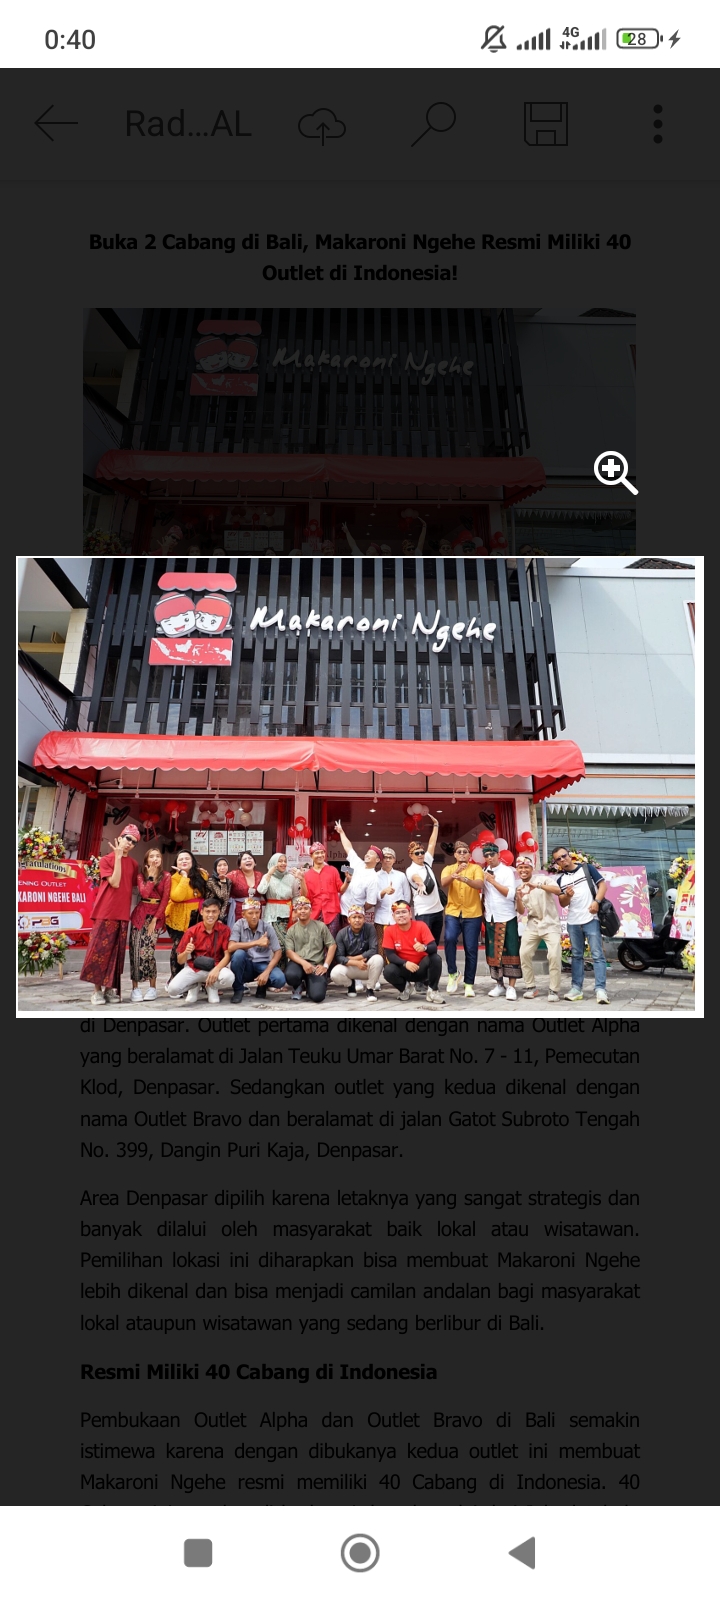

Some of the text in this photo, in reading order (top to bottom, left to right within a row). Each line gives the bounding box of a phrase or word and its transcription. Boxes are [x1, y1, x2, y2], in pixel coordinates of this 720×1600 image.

[44, 29, 97, 50] 0:40
[562, 26, 580, 38] 4G
[626, 31, 648, 47] 28
[89, 233, 632, 254] Buka 2 Cabang di Bali, Makaroni Ngehe Resmi Miliki 40
[261, 264, 458, 282] Outlet di Indonesia!
[272, 347, 475, 385] Makaroni Ngehe
[250, 606, 497, 652] Makaroni Ngehe
[47, 891, 71, 903] NGEHE
[71, 892, 87, 903] BALI
[79, 1018, 640, 1037] di Denpasar. Outlet pertama dikenal dengan nama Outlet Alpha
[79, 1051, 122, 1068] yang
[127, 1047, 215, 1064] beralamat
[218, 1047, 234, 1064] di
[238, 1047, 283, 1064] Jalan
[287, 1047, 342, 1064] Teuku
[347, 1047, 394, 1064] Umar
[399, 1047, 445, 1064] Barat
[449, 1047, 478, 1064] No.
[484, 1047, 495, 1064] 7
[513, 1047, 539, 1068] 11,
[545, 1047, 640, 1064] Pemecutan
[80, 1078, 640, 1099] Klod, Denpasar. Sedangkan outlet yang kedua dikenal dengan
[80, 1110, 640, 1131] nama Outlet Bravo dan beralamat di jalan Gatot Subroto Tengah
[80, 1141, 403, 1162] No. 399, Dangin Puri Kaja, Denpasar.
[79, 1189, 640, 1210] Area Denpasar dipilih karena letaknya yang sangat strategis dan
[80, 1220, 639, 1241] banyak dilalui oleh masyarakat baik lokal atau wisatawan.
[80, 1251, 641, 1272] Pemilihan lokasi ini diharapkan bisa membuat Makaroni Ngehe
[80, 1282, 641, 1303] lebih dikenal dan bisa menjadi camilan andalan bagi masyarakat
[80, 1314, 544, 1335] lokal ataupun wisatawan yang sedang berlibur di Bali.
[80, 1363, 438, 1384] Resmi Miliki 40 Cabang di Indonesia
[80, 1411, 640, 1432] Pembukaan Outlet Alpha dan Outlet Bravo di Bali semakin
[80, 1442, 641, 1463] istimewa karena dengan dibukanya kedua outlet ini membuat
[80, 1473, 641, 1494] Makaroni Ngehe resmi memiliki 40 Cabang di Indonesia. 40
